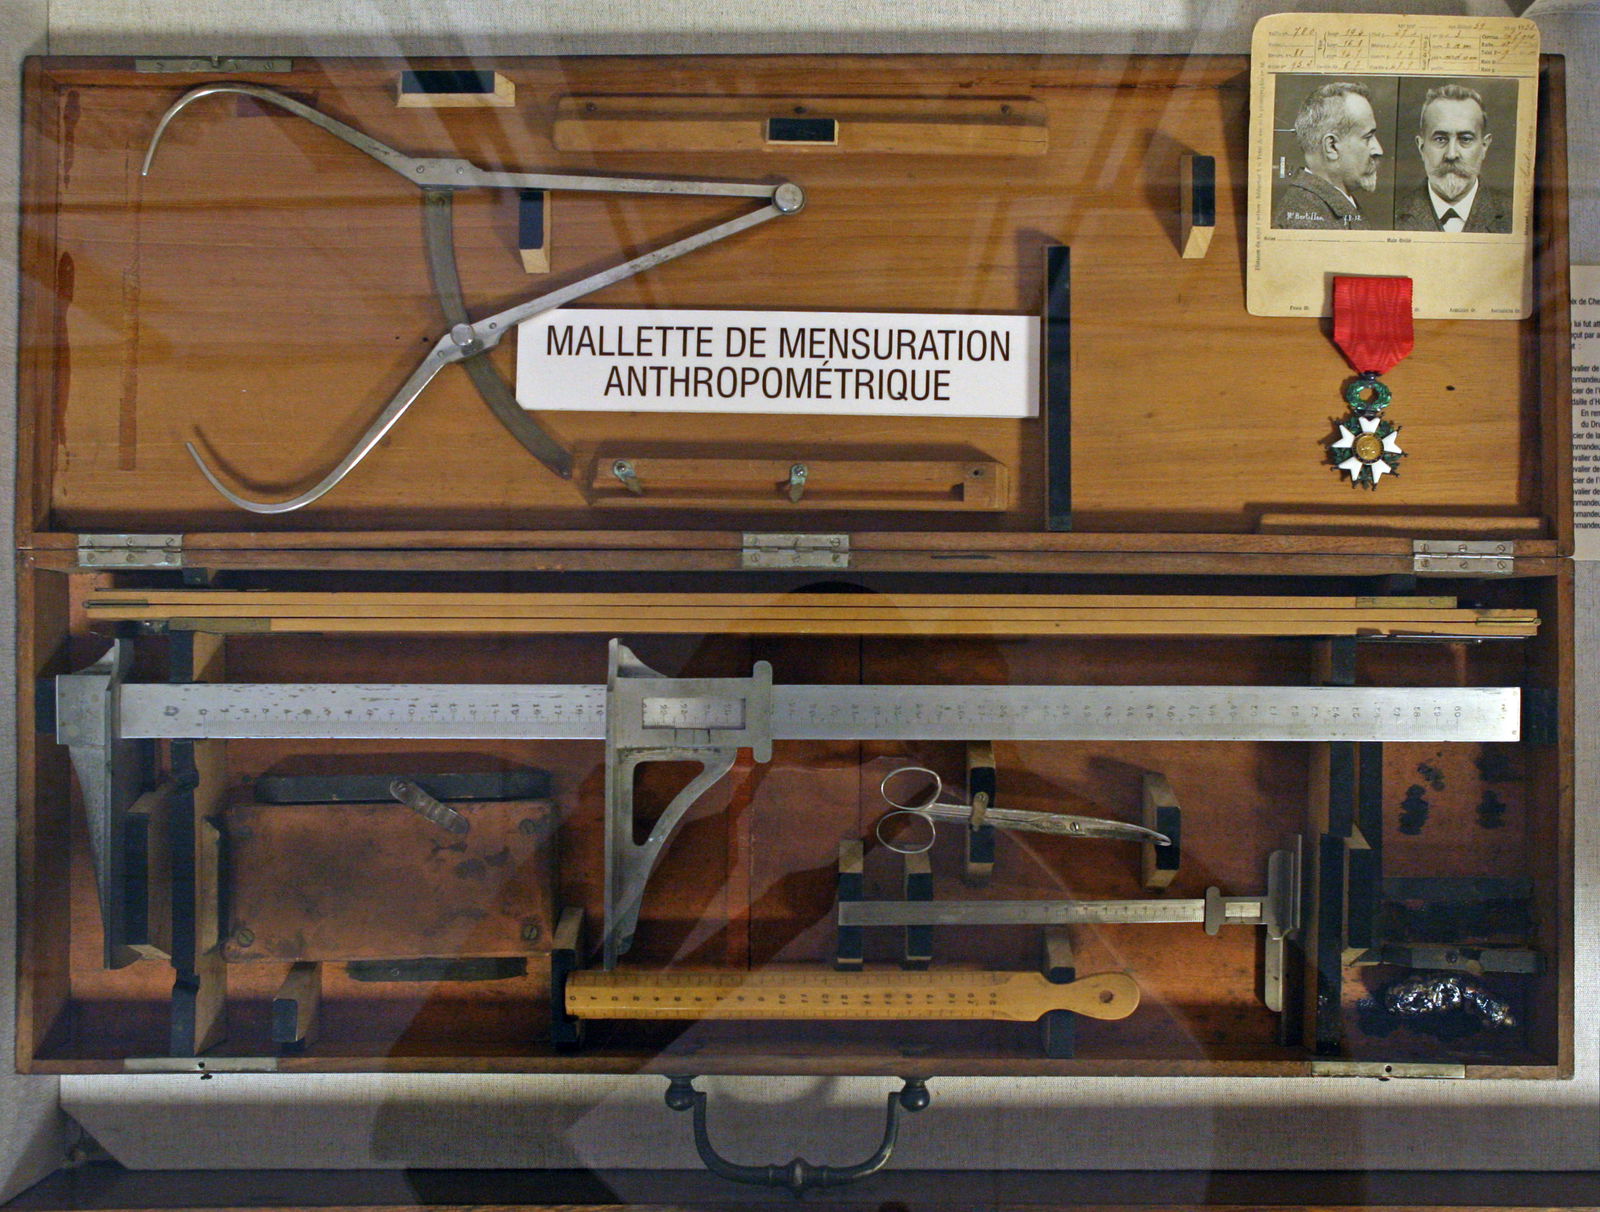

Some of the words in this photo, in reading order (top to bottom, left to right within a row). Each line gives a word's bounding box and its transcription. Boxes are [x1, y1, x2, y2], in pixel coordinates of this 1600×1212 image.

[546, 325, 713, 357] MALLETTE
[725, 327, 767, 358] DE
[779, 328, 1011, 362] MENSURATION
[603, 360, 951, 401] ANTHROPOMÉTRIQUE
